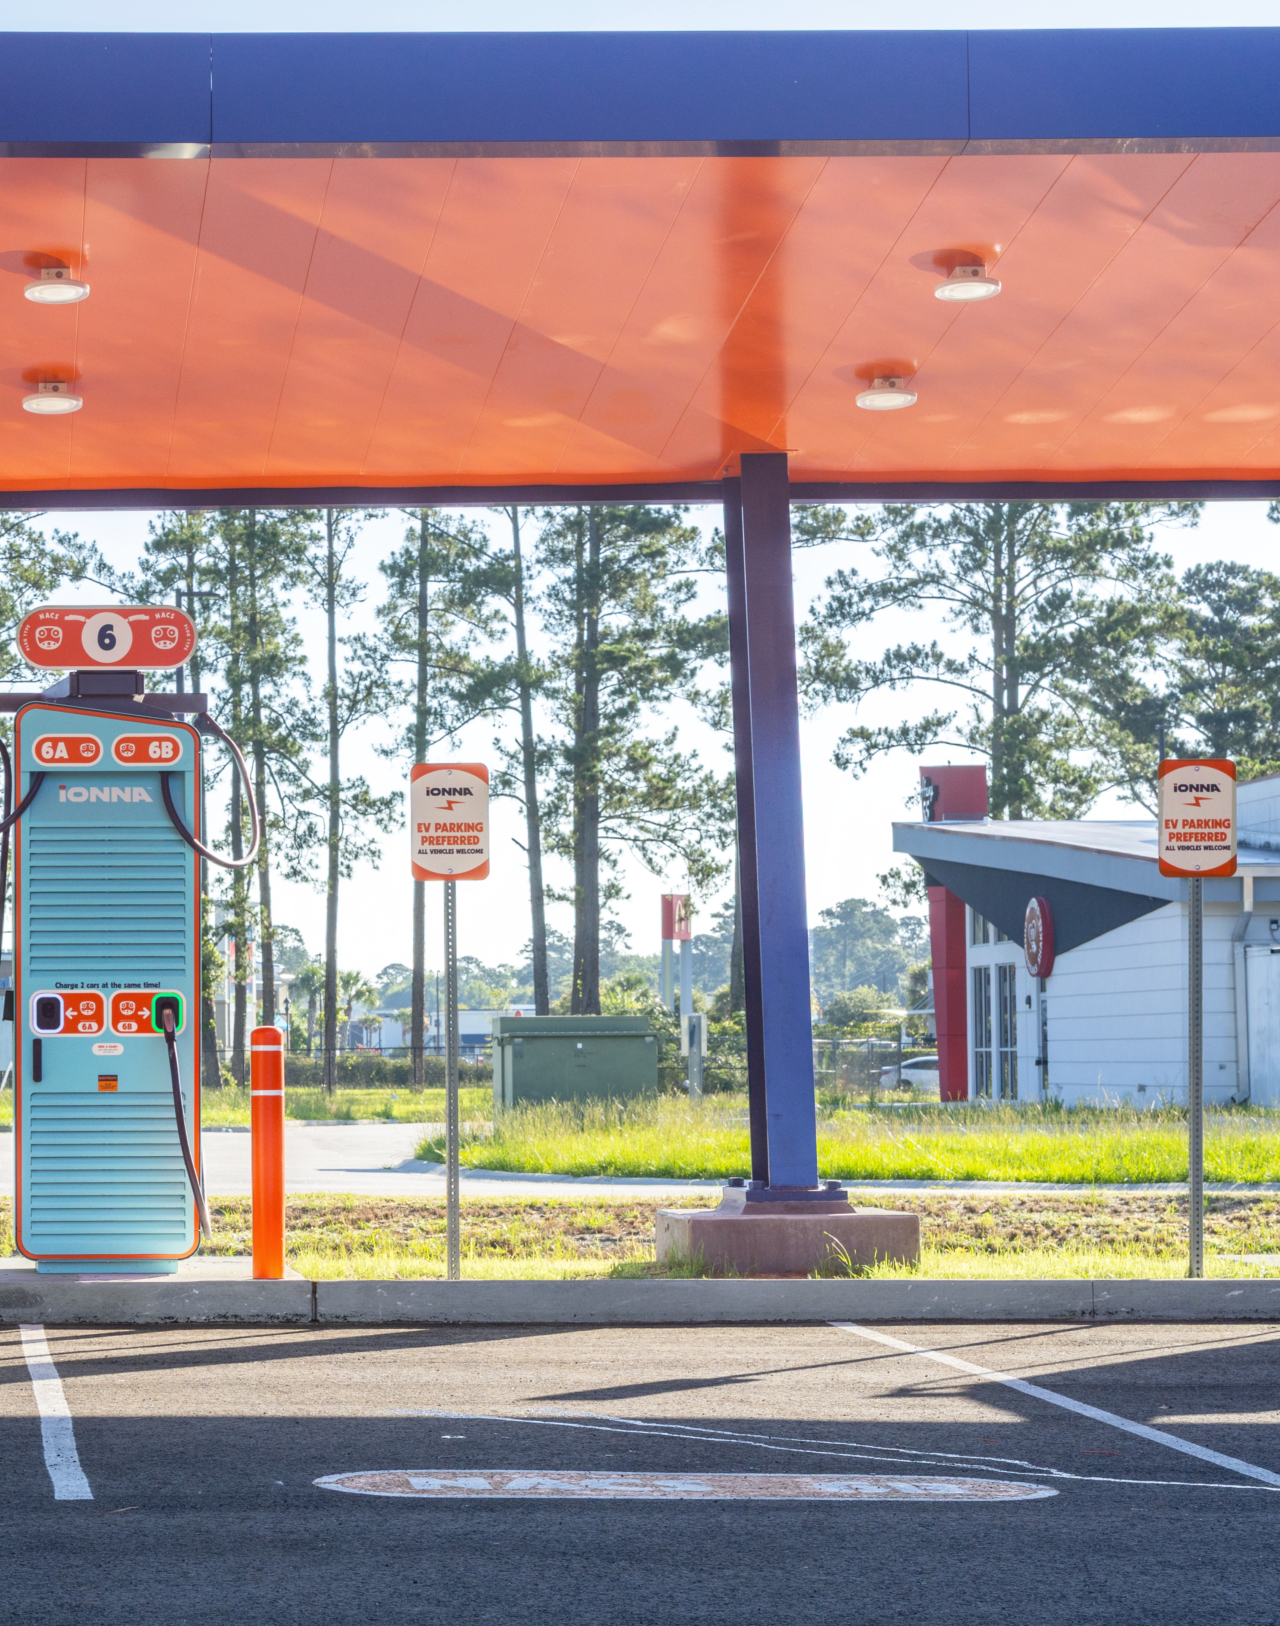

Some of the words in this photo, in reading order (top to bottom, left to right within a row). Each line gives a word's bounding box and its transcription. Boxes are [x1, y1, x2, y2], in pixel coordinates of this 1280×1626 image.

[39, 612, 59, 620] NACS
[155, 612, 175, 620] NACS
[97, 623, 117, 651] 6
[41, 741, 69, 759] 6A
[148, 741, 173, 759] 6B
[417, 822, 431, 833] EV
[434, 822, 484, 833] PARKING
[1164, 819, 1178, 829] EV
[1182, 818, 1231, 829] PARKING
[421, 835, 480, 846] PREFERRED
[1168, 832, 1227, 842] PREFERRED
[55, 981, 79, 990] Charge
[110, 981, 122, 989] the
[143, 981, 161, 989] time!
[81, 1023, 93, 1031] 6A
